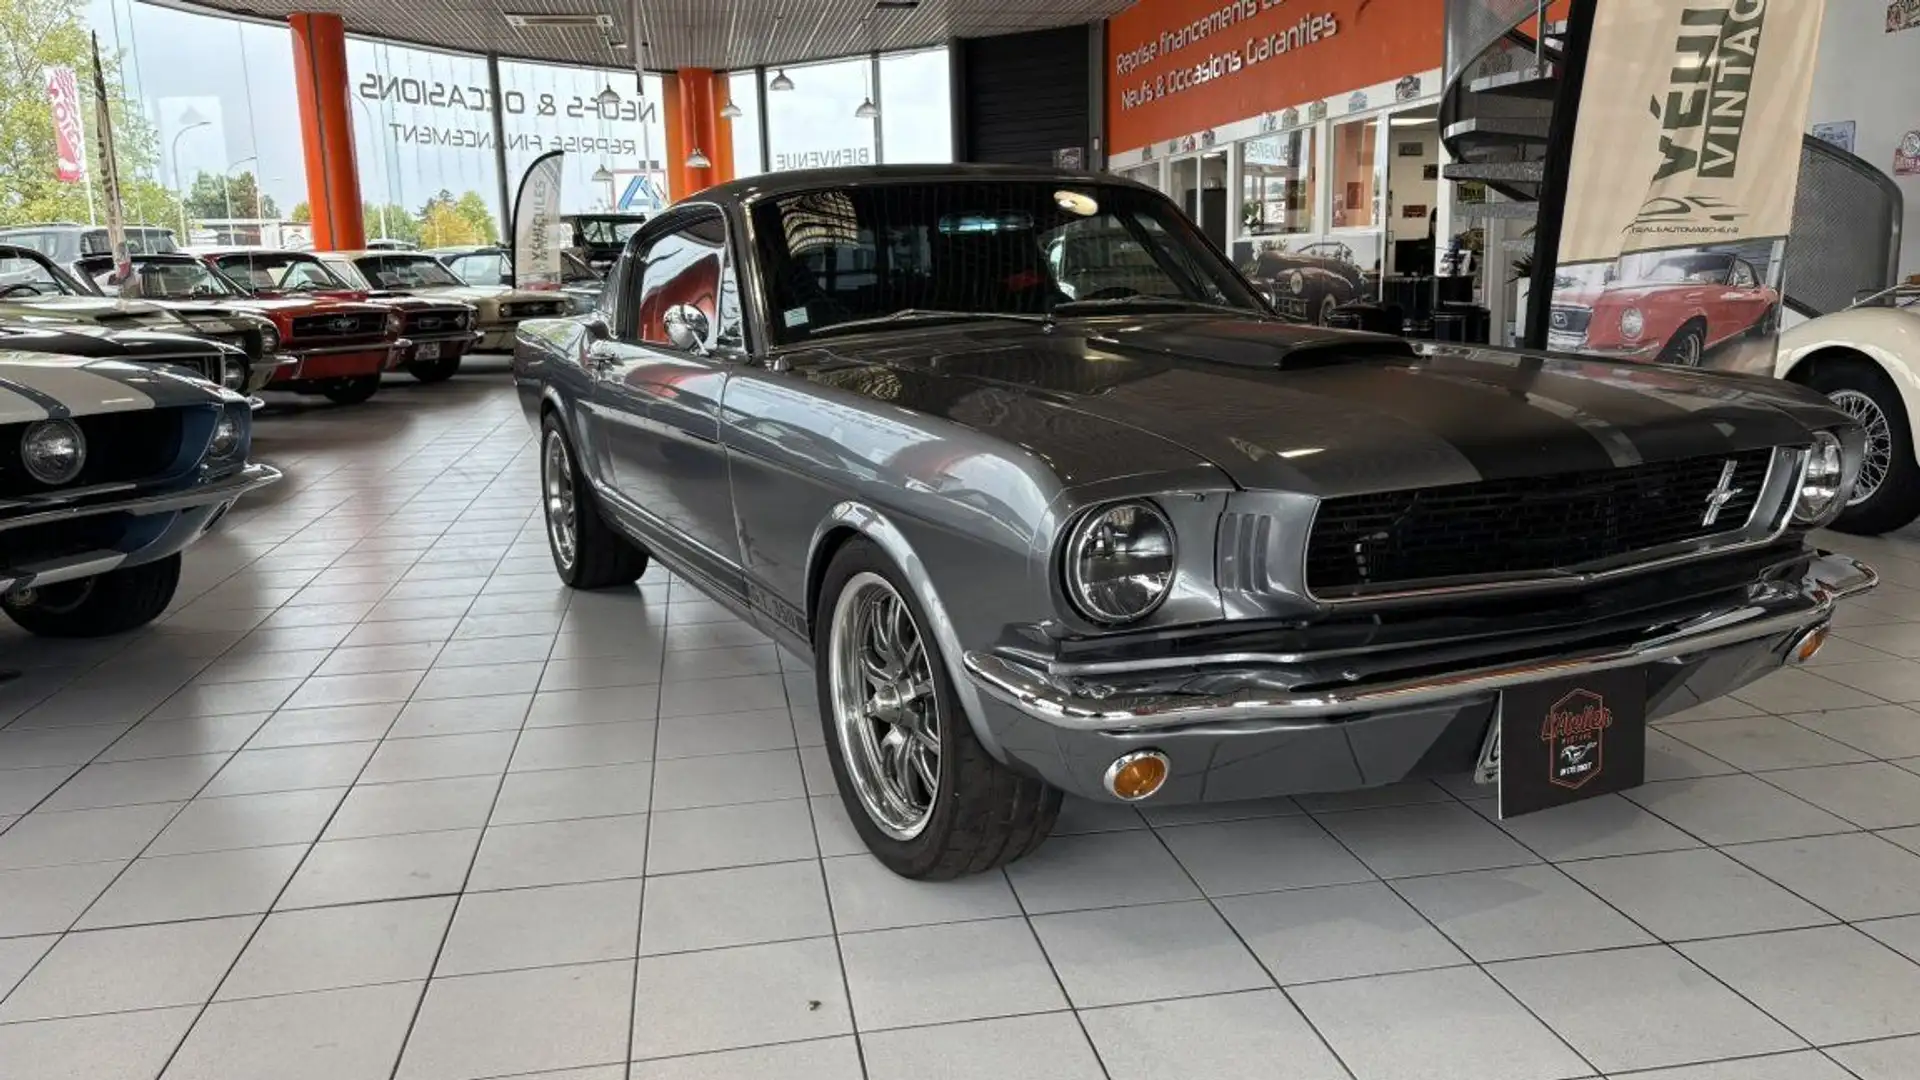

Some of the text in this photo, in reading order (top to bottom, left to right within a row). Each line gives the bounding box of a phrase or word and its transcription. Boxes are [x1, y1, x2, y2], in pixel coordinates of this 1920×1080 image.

[1116, 0, 1258, 75] Reprise financements
[1121, 12, 1337, 110] Neufs & Occasions Garanties
